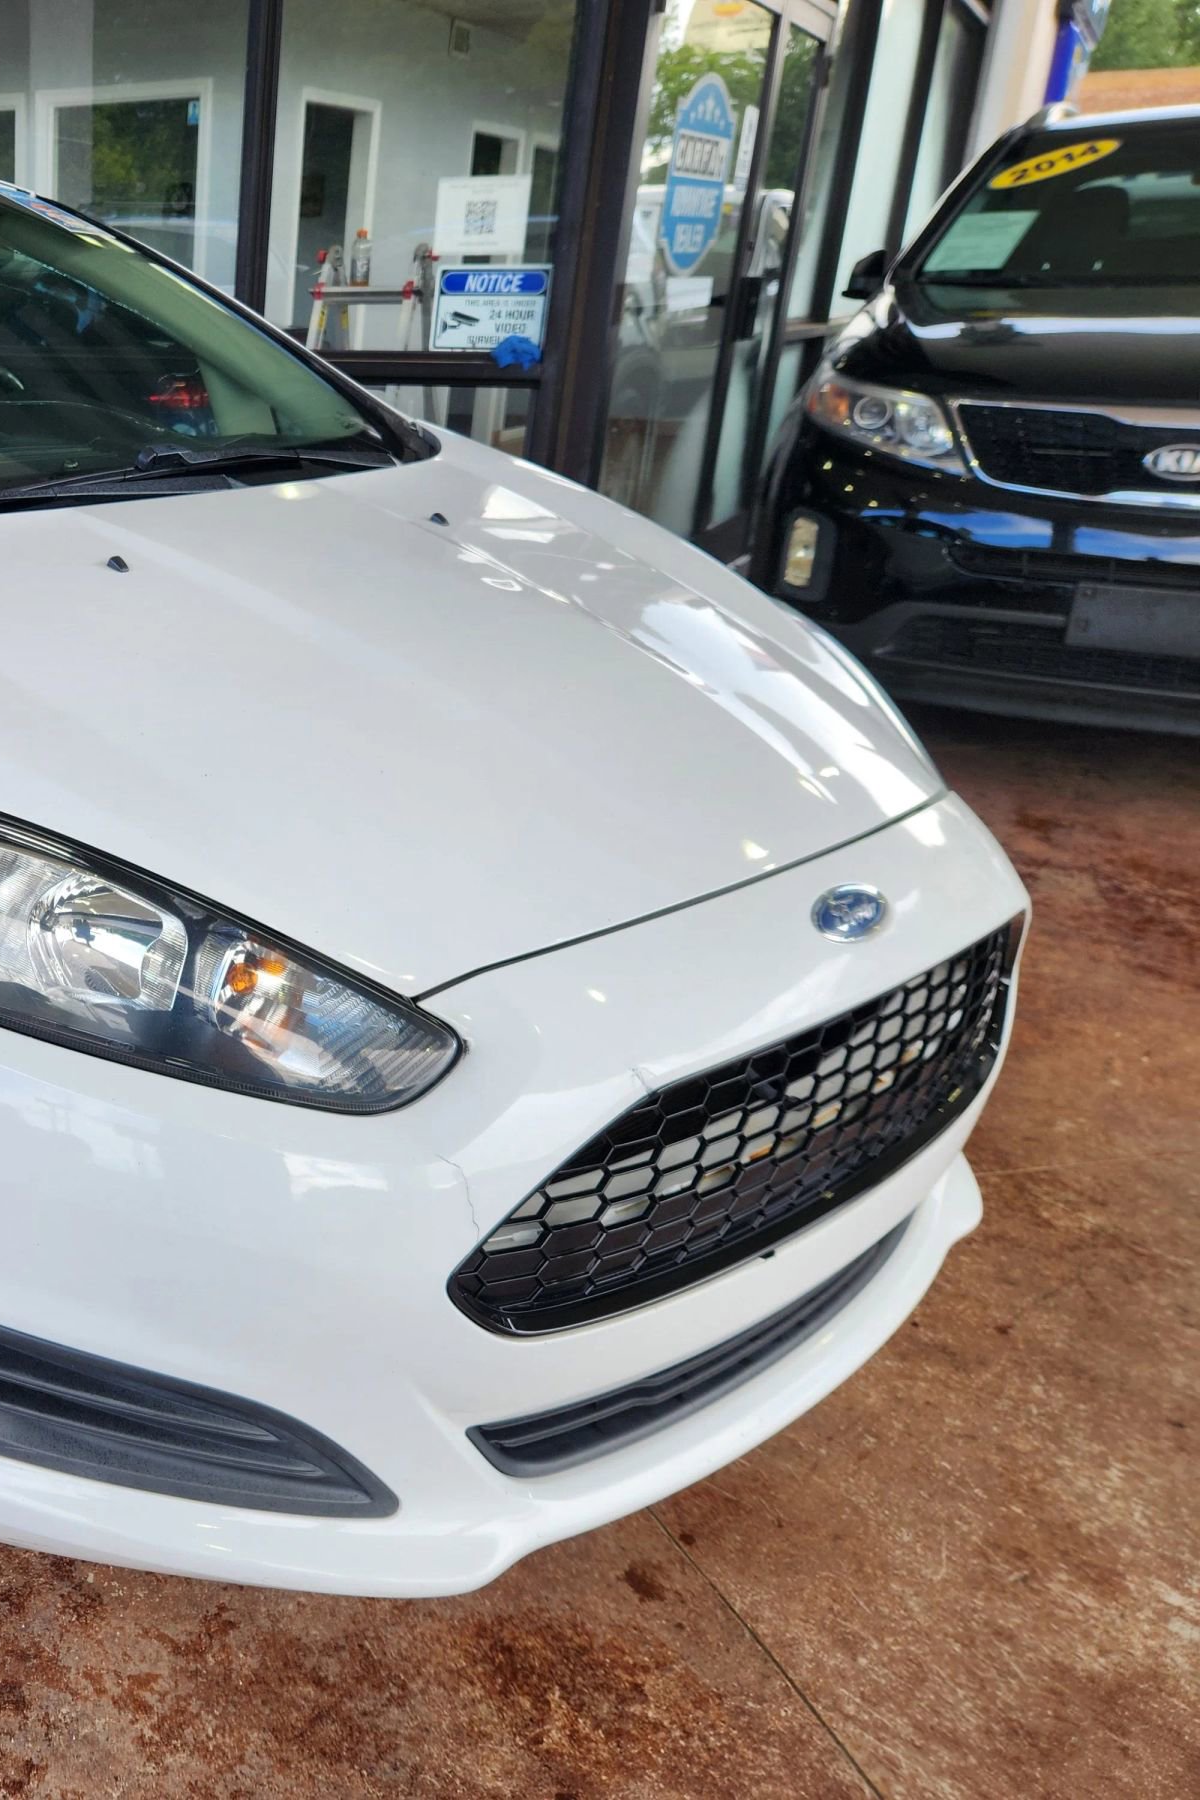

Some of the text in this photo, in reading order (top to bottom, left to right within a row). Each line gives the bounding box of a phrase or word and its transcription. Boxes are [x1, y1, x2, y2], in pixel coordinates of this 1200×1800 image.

[1008, 144, 1098, 183] 2014
[464, 273, 525, 293] NOTICE
[489, 309, 535, 321] 24 HOUR
[494, 322, 527, 334] VIDEO
